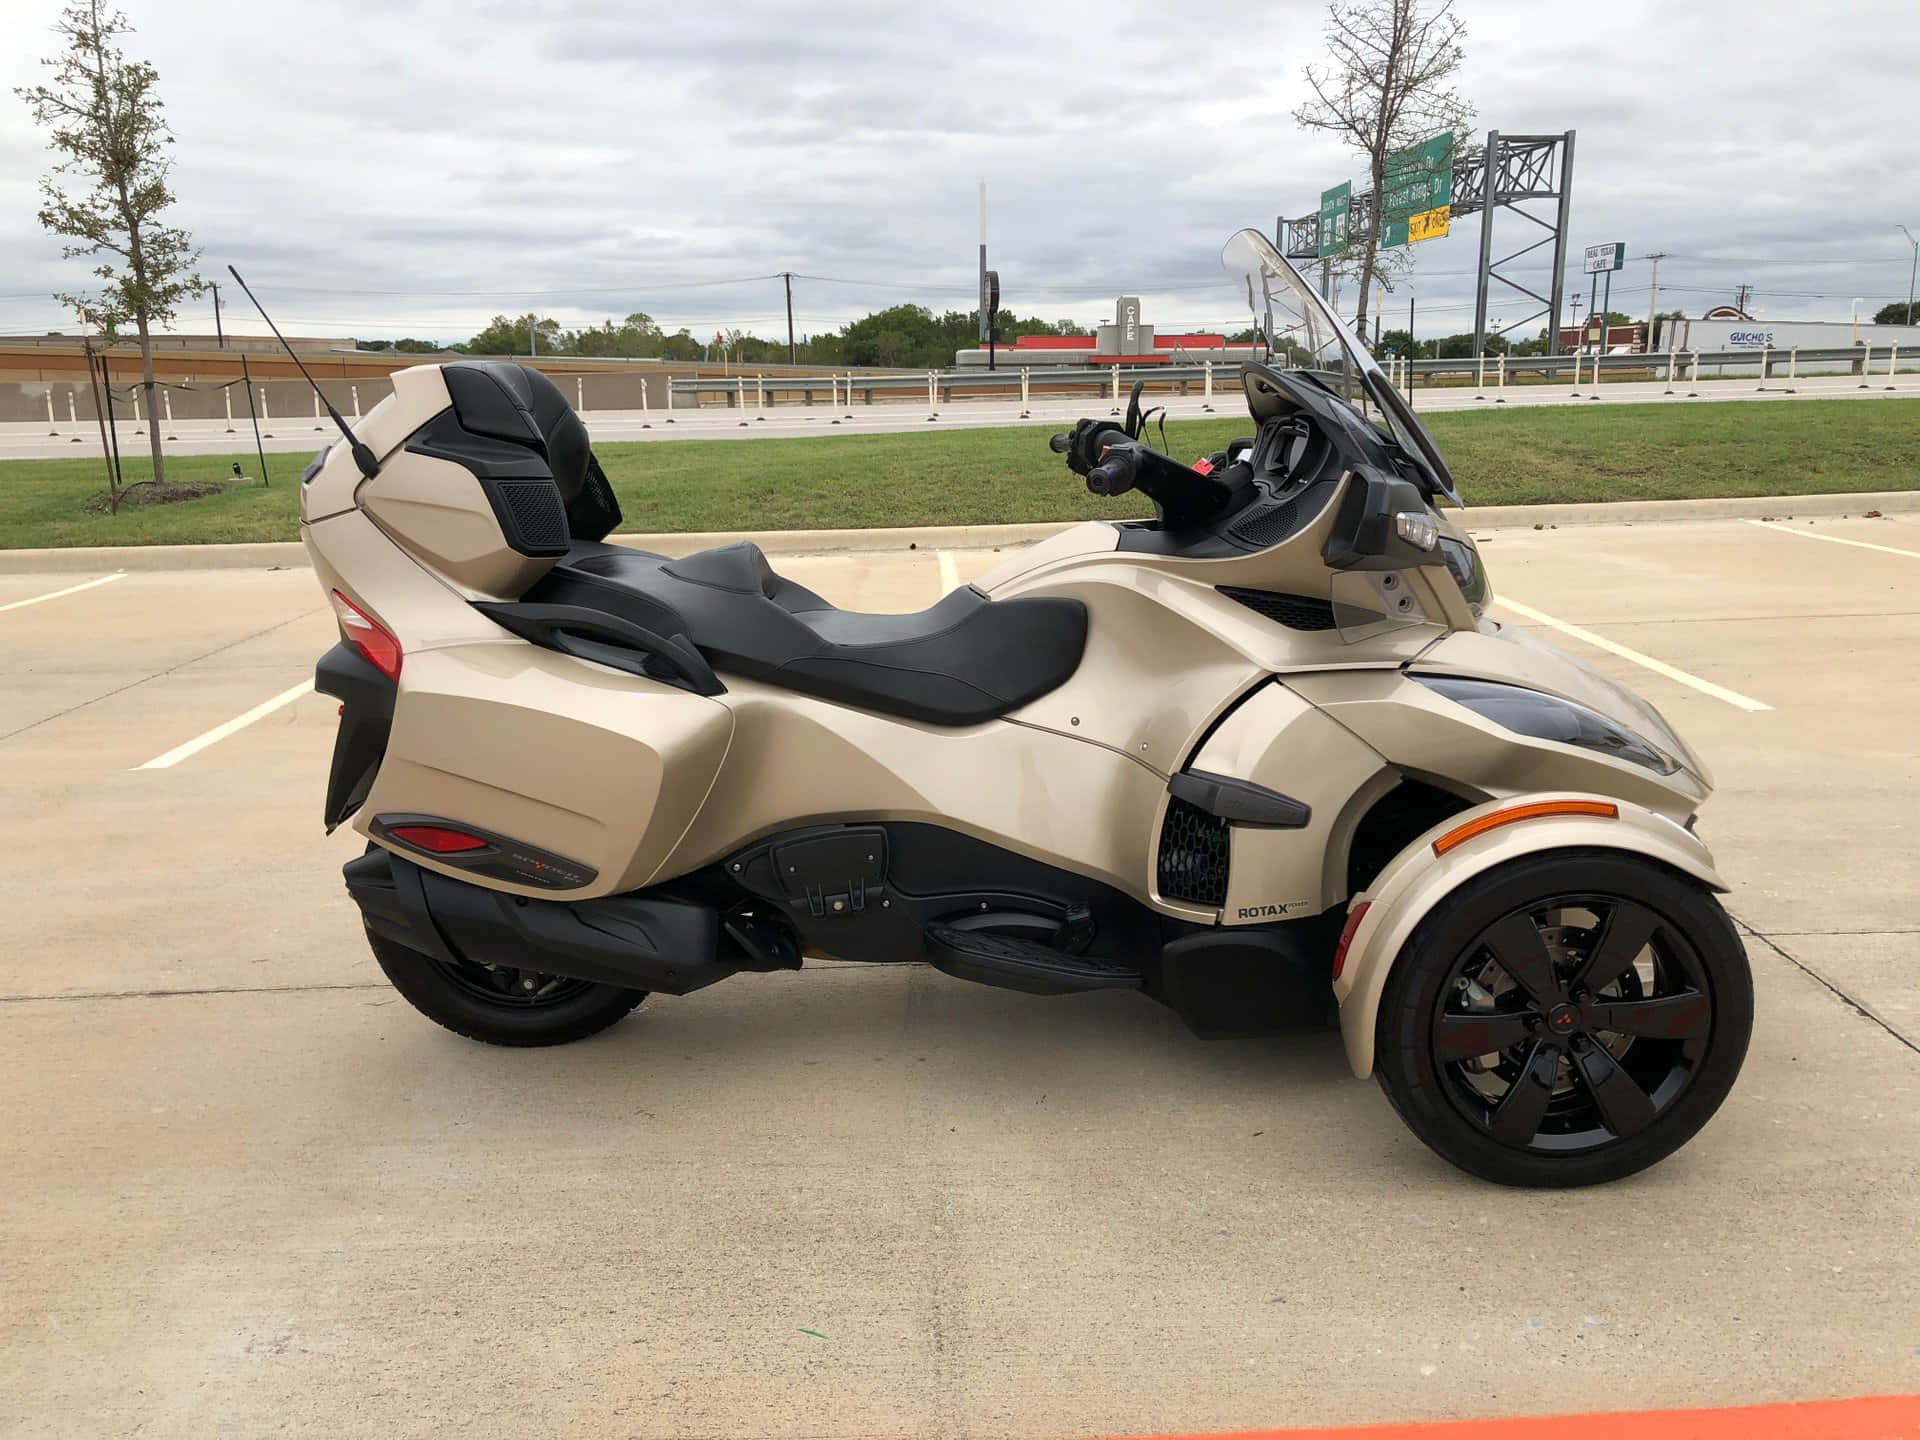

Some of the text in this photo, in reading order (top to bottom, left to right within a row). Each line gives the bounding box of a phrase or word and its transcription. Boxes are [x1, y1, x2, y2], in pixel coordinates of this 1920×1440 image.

[1389, 190, 1409, 208] Forest
[1434, 178, 1442, 194] Dr
[1600, 246, 1615, 256] TEXAS
[1126, 305, 1136, 341] CAFE
[1238, 904, 1288, 919] ROTAX
